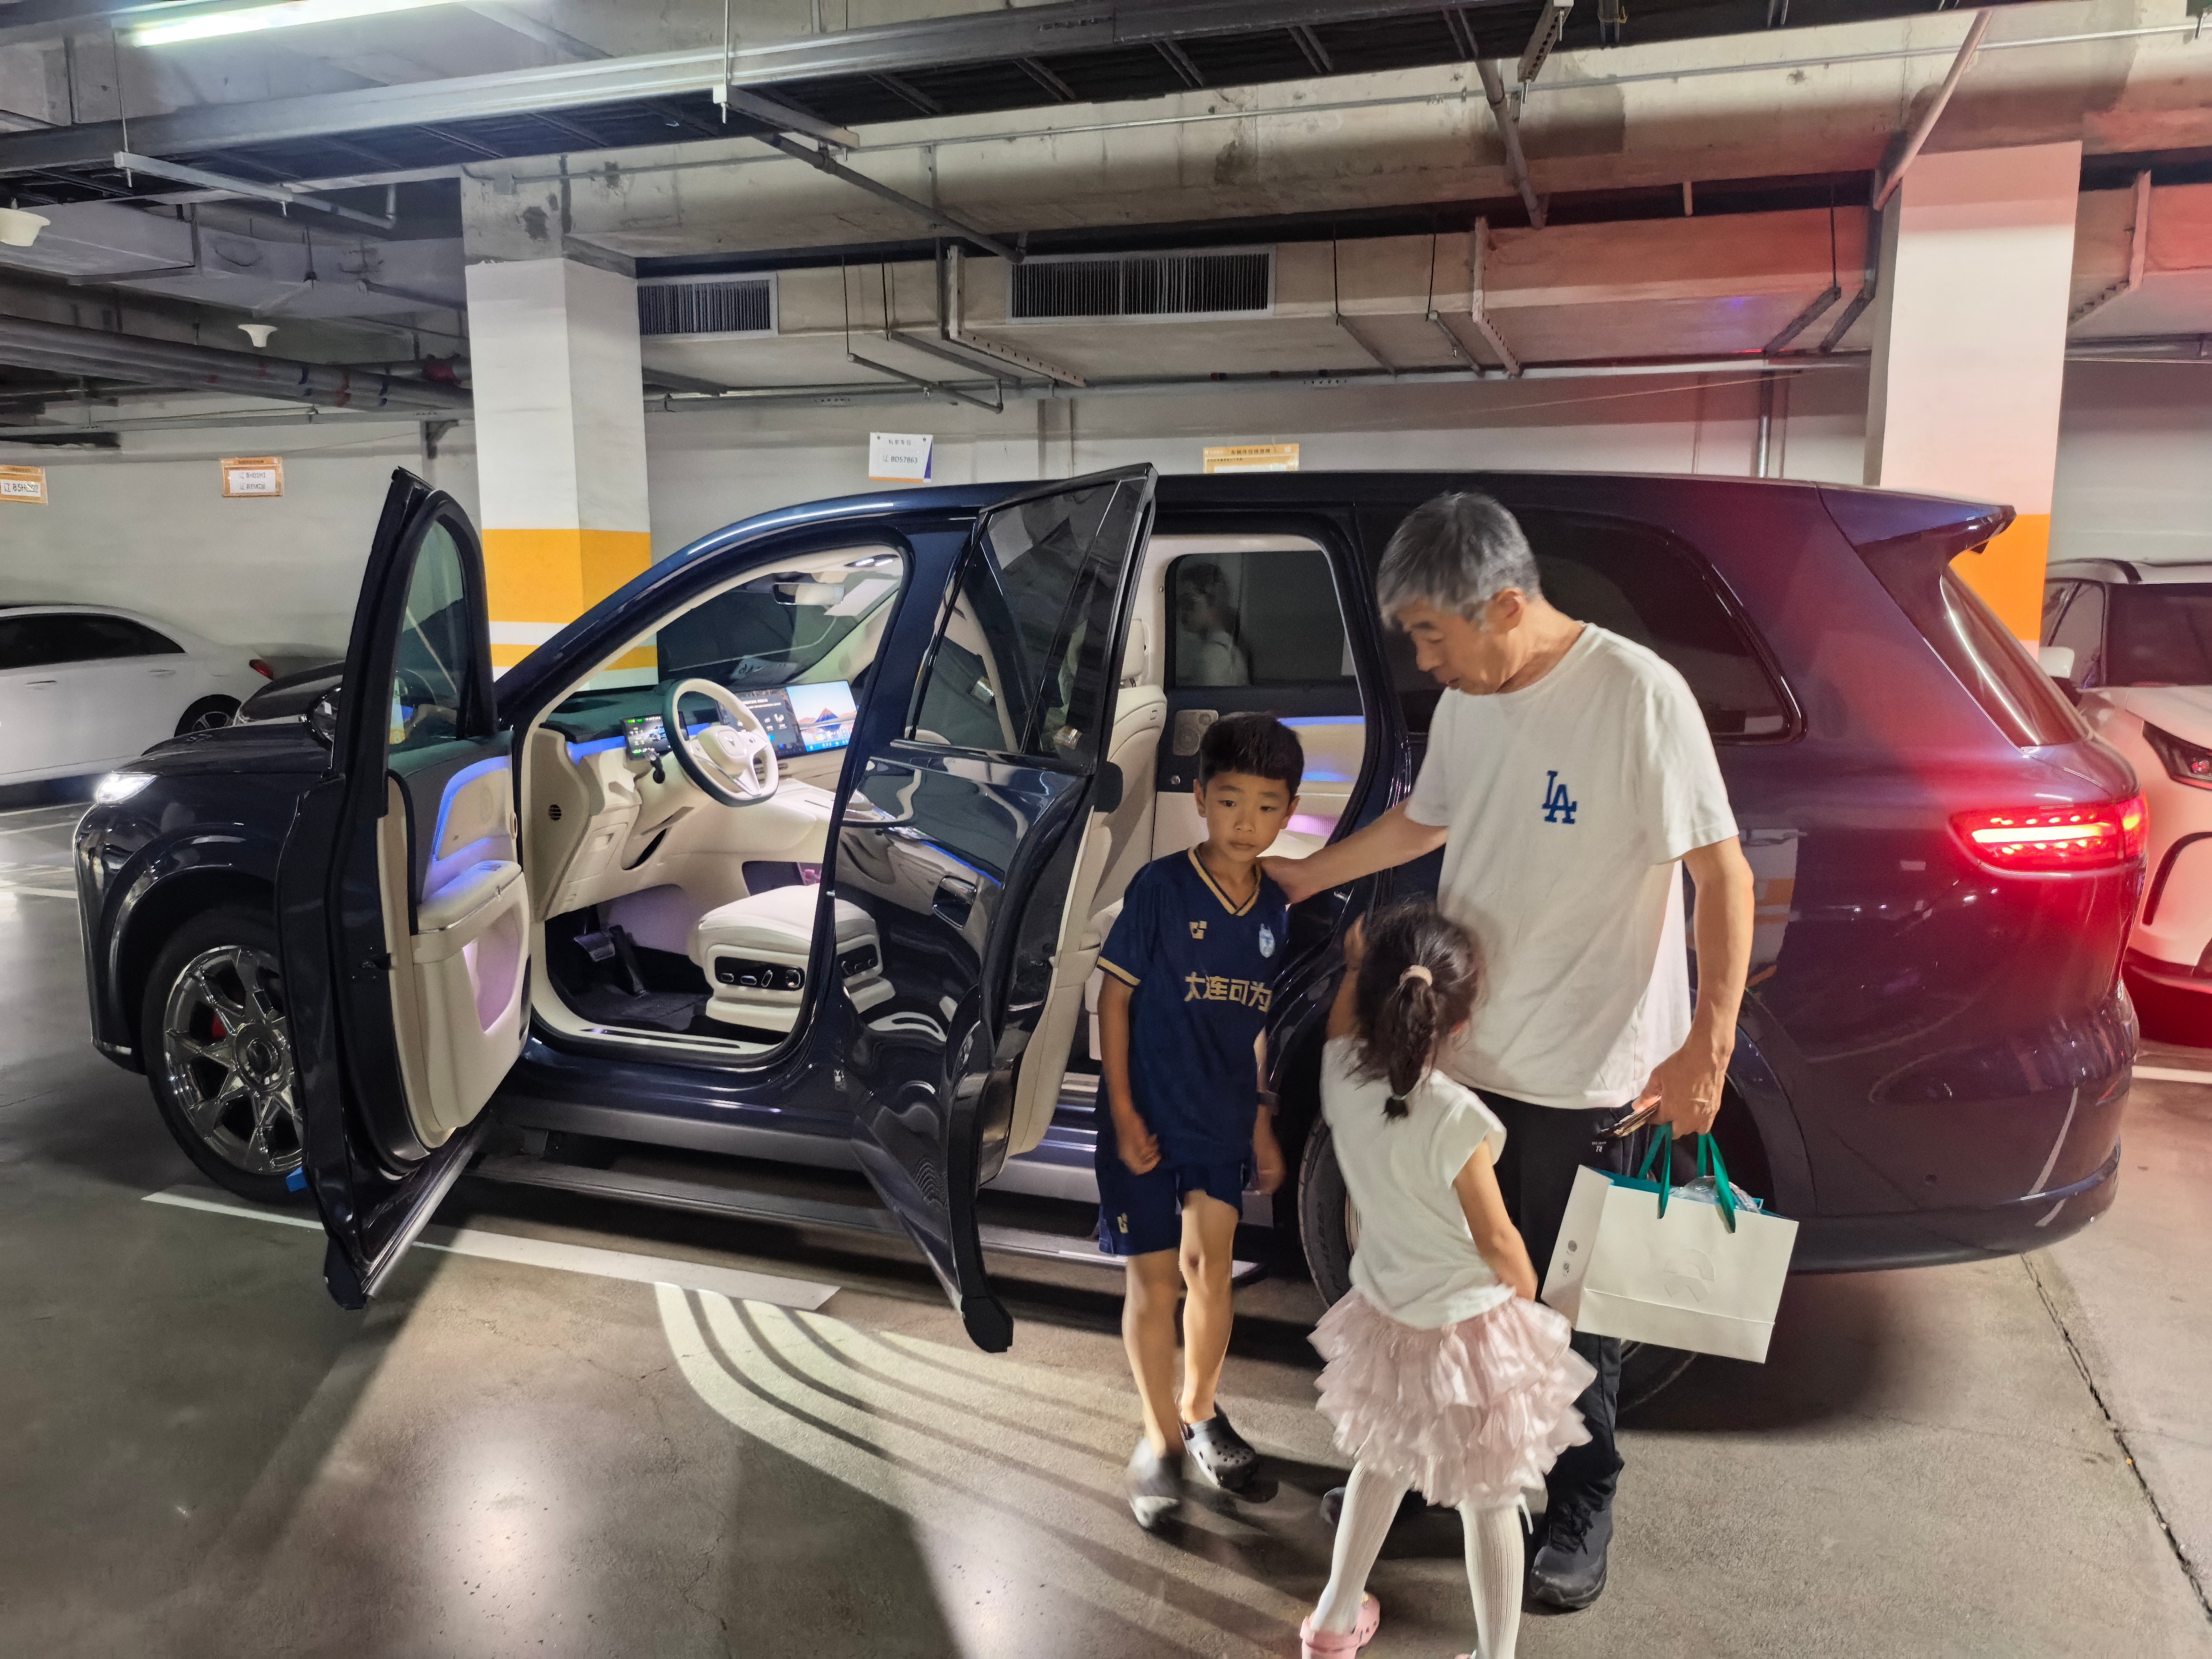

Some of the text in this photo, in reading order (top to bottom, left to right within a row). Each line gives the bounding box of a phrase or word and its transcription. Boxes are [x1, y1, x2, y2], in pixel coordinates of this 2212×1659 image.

[1541, 770, 1577, 825] LA
[1184, 971, 1273, 1013] 大连可为
